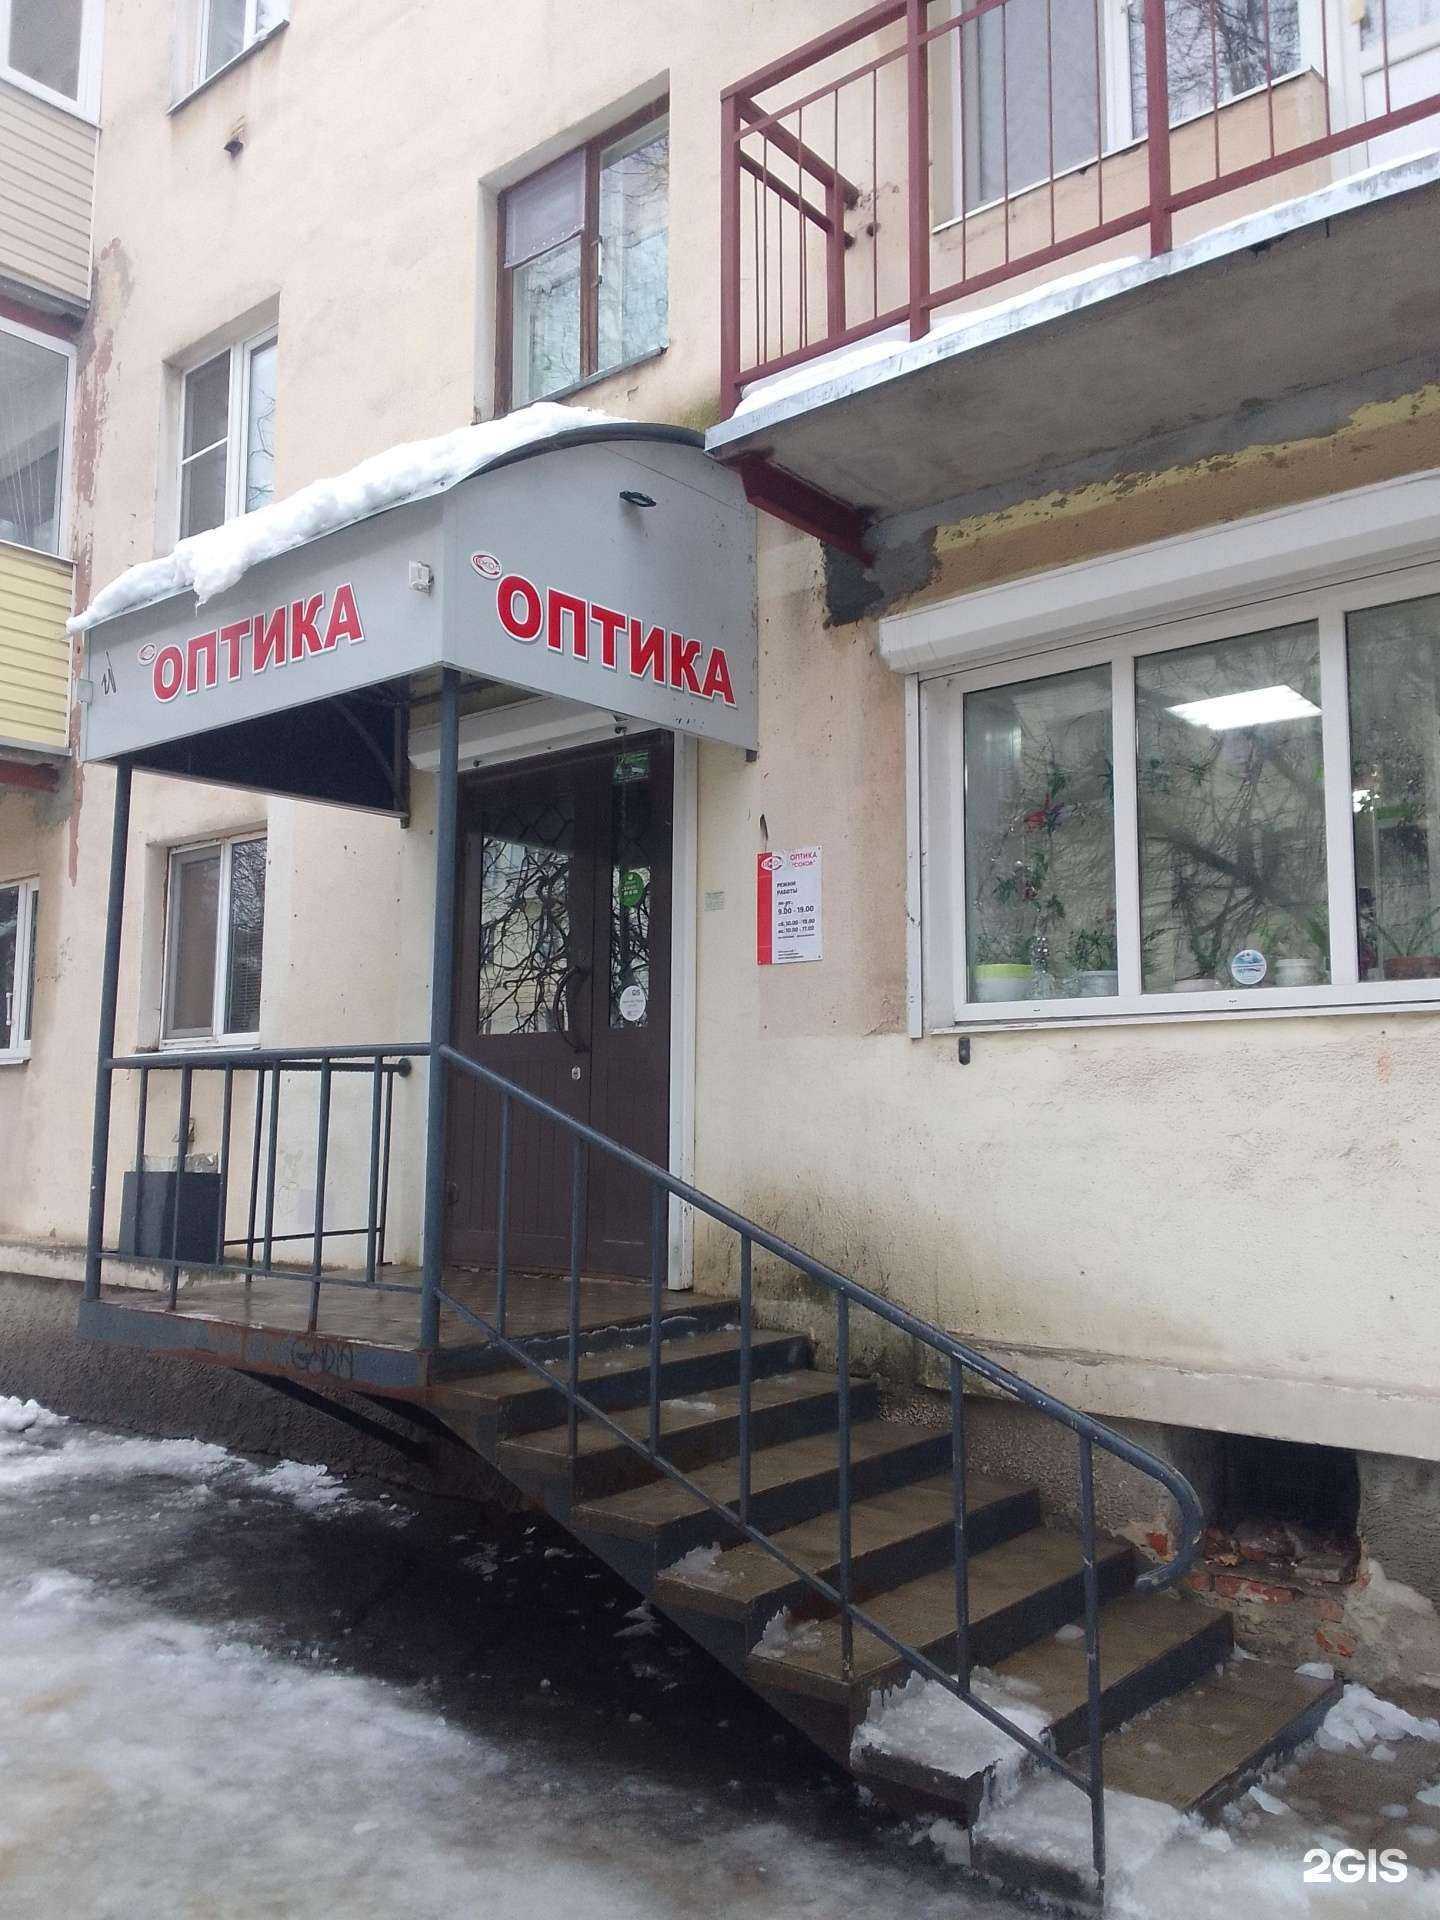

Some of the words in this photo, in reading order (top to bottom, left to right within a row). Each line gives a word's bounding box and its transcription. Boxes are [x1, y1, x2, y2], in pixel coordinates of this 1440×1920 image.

[152, 583, 365, 703] ОПТИКА
[496, 573, 738, 708] ОПТИКА
[790, 851, 817, 861] ОПТИКА
[797, 905, 815, 914] 19.00
